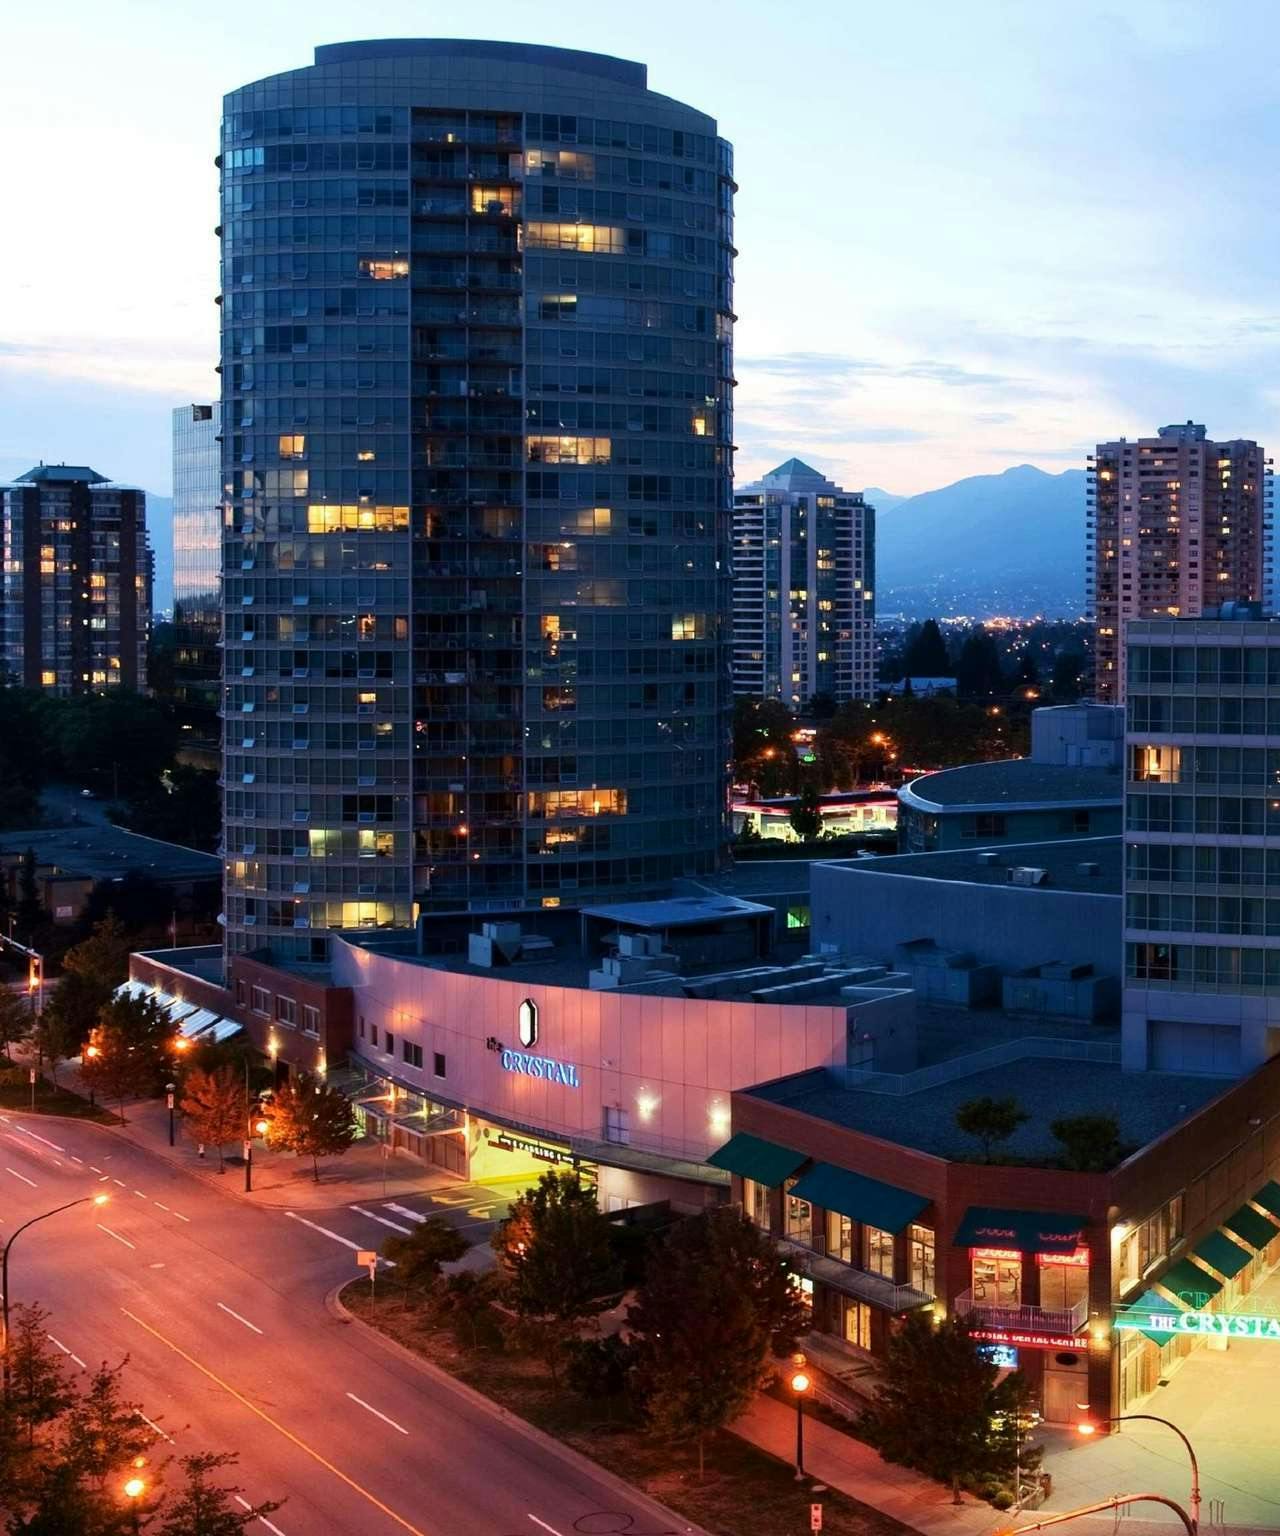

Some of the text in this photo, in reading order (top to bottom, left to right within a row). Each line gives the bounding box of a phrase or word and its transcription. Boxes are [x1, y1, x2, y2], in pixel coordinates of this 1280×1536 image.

[501, 1048, 579, 1088] CRYSTAL
[518, 1142, 555, 1159] PARKING
[1149, 1315, 1177, 1330] THE
